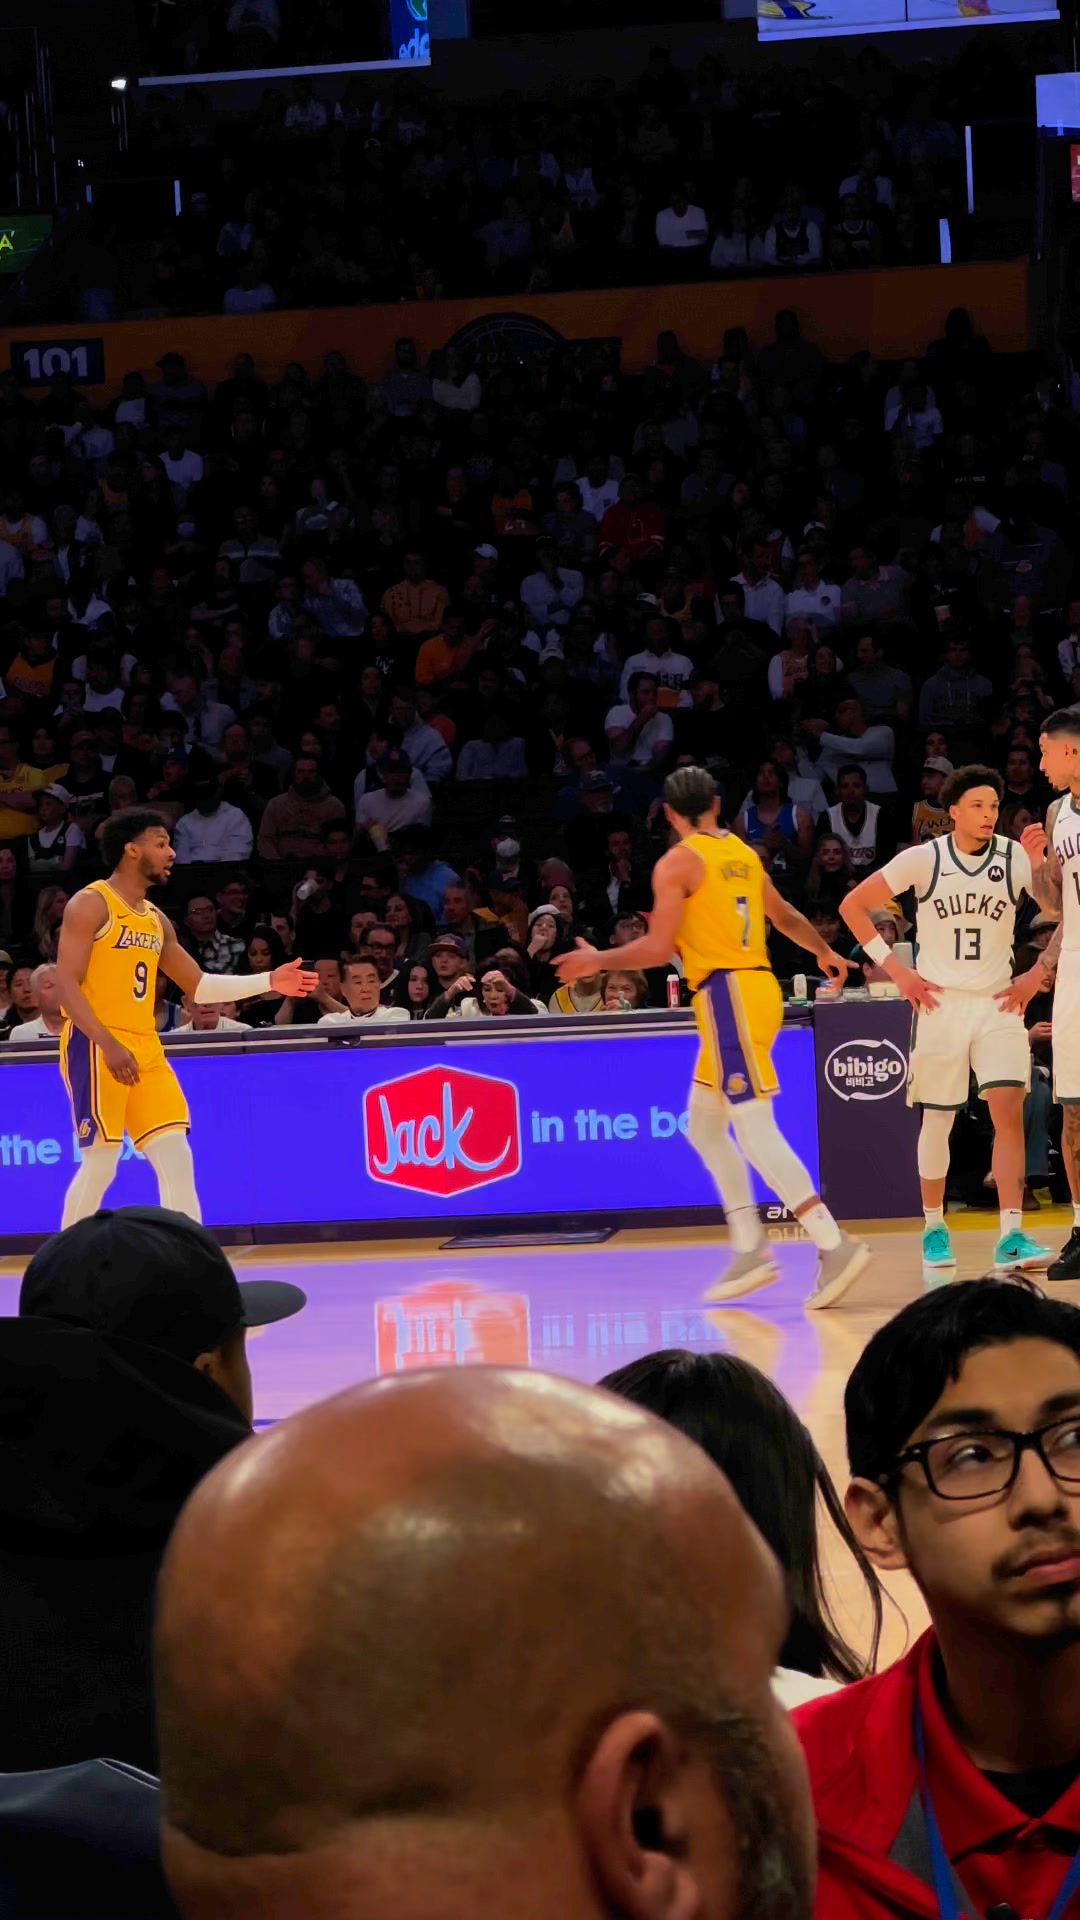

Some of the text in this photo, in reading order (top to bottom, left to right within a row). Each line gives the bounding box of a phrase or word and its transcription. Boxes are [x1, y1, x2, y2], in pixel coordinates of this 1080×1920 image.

[24, 346, 88, 379] 101
[933, 893, 1007, 921] BUCKS
[954, 928, 981, 960] 13
[133, 961, 148, 1001] 9
[833, 1056, 902, 1082] bibigo
[845, 1077, 875, 1087] 비비고
[373, 1082, 512, 1174] Jack
[531, 1110, 564, 1143] in
[574, 1109, 639, 1141] the
[0, 1134, 62, 1166] the
